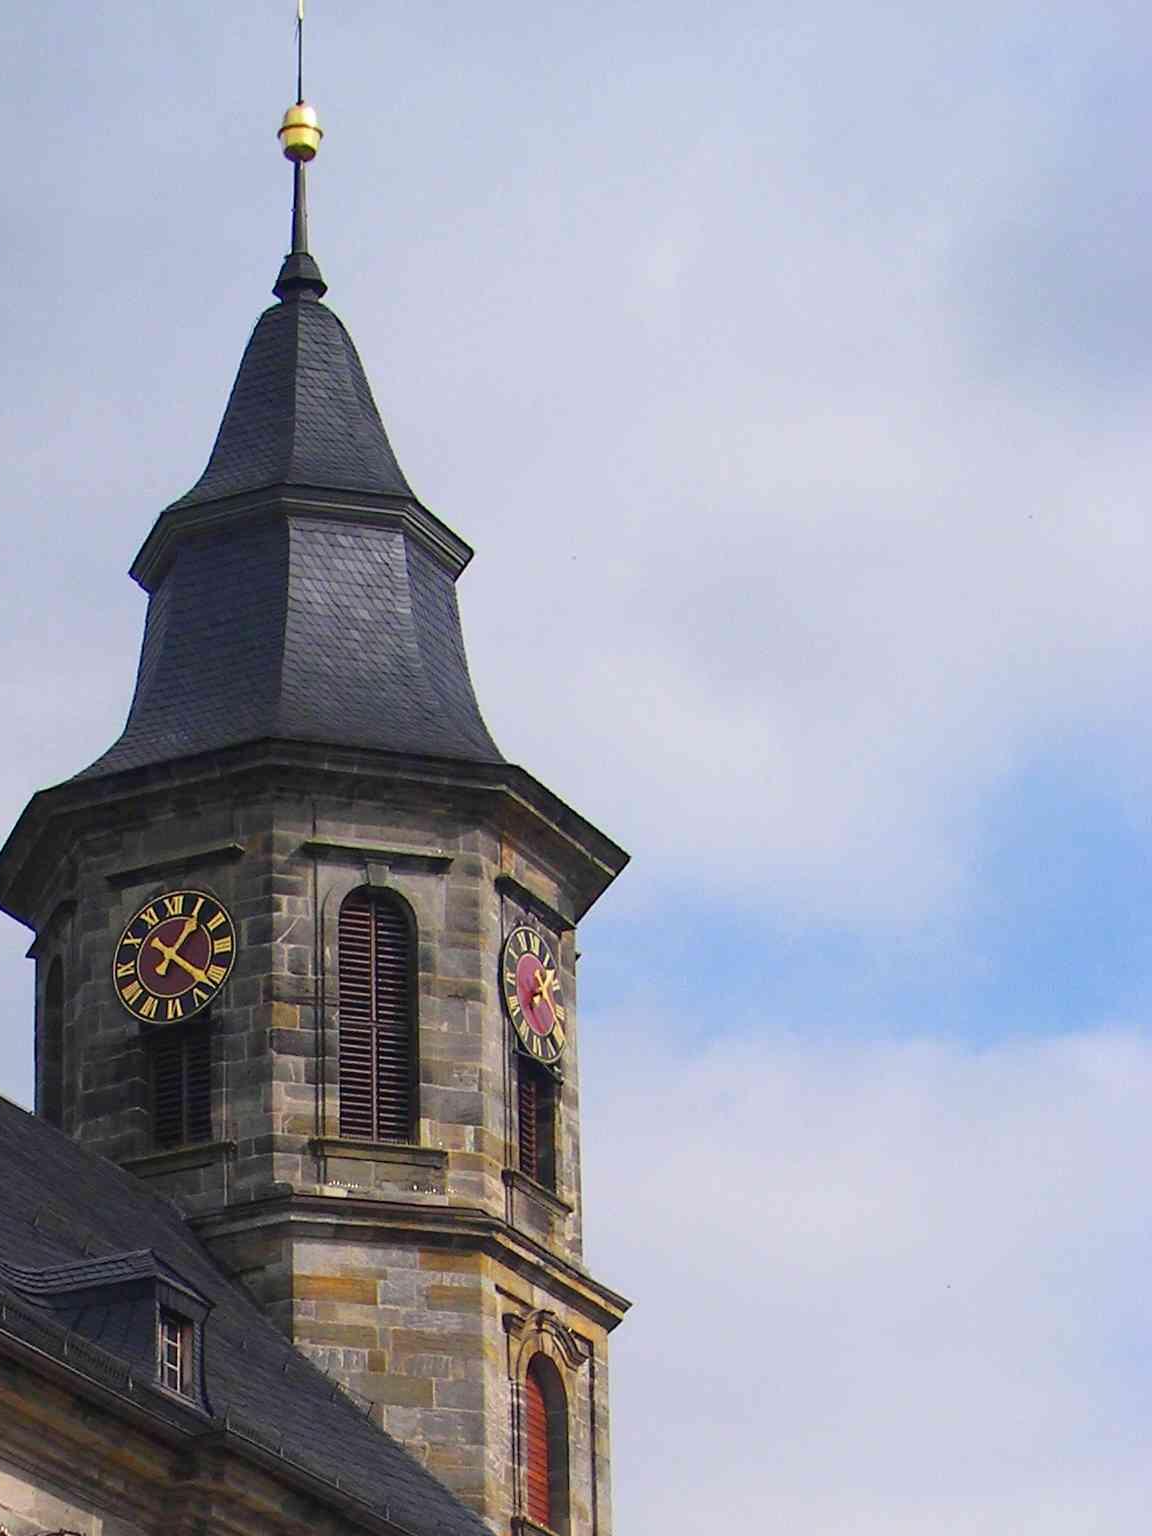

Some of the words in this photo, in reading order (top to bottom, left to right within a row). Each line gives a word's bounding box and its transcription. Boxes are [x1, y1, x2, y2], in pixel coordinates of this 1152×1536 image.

[164, 895, 184, 917] XII
[140, 906, 160, 929] XI
[207, 911, 226, 931] II
[123, 931, 142, 949] X
[214, 936, 232, 955] III
[139, 996, 159, 1018] VII
[193, 988, 209, 1007] V
[167, 998, 184, 1019] VI
